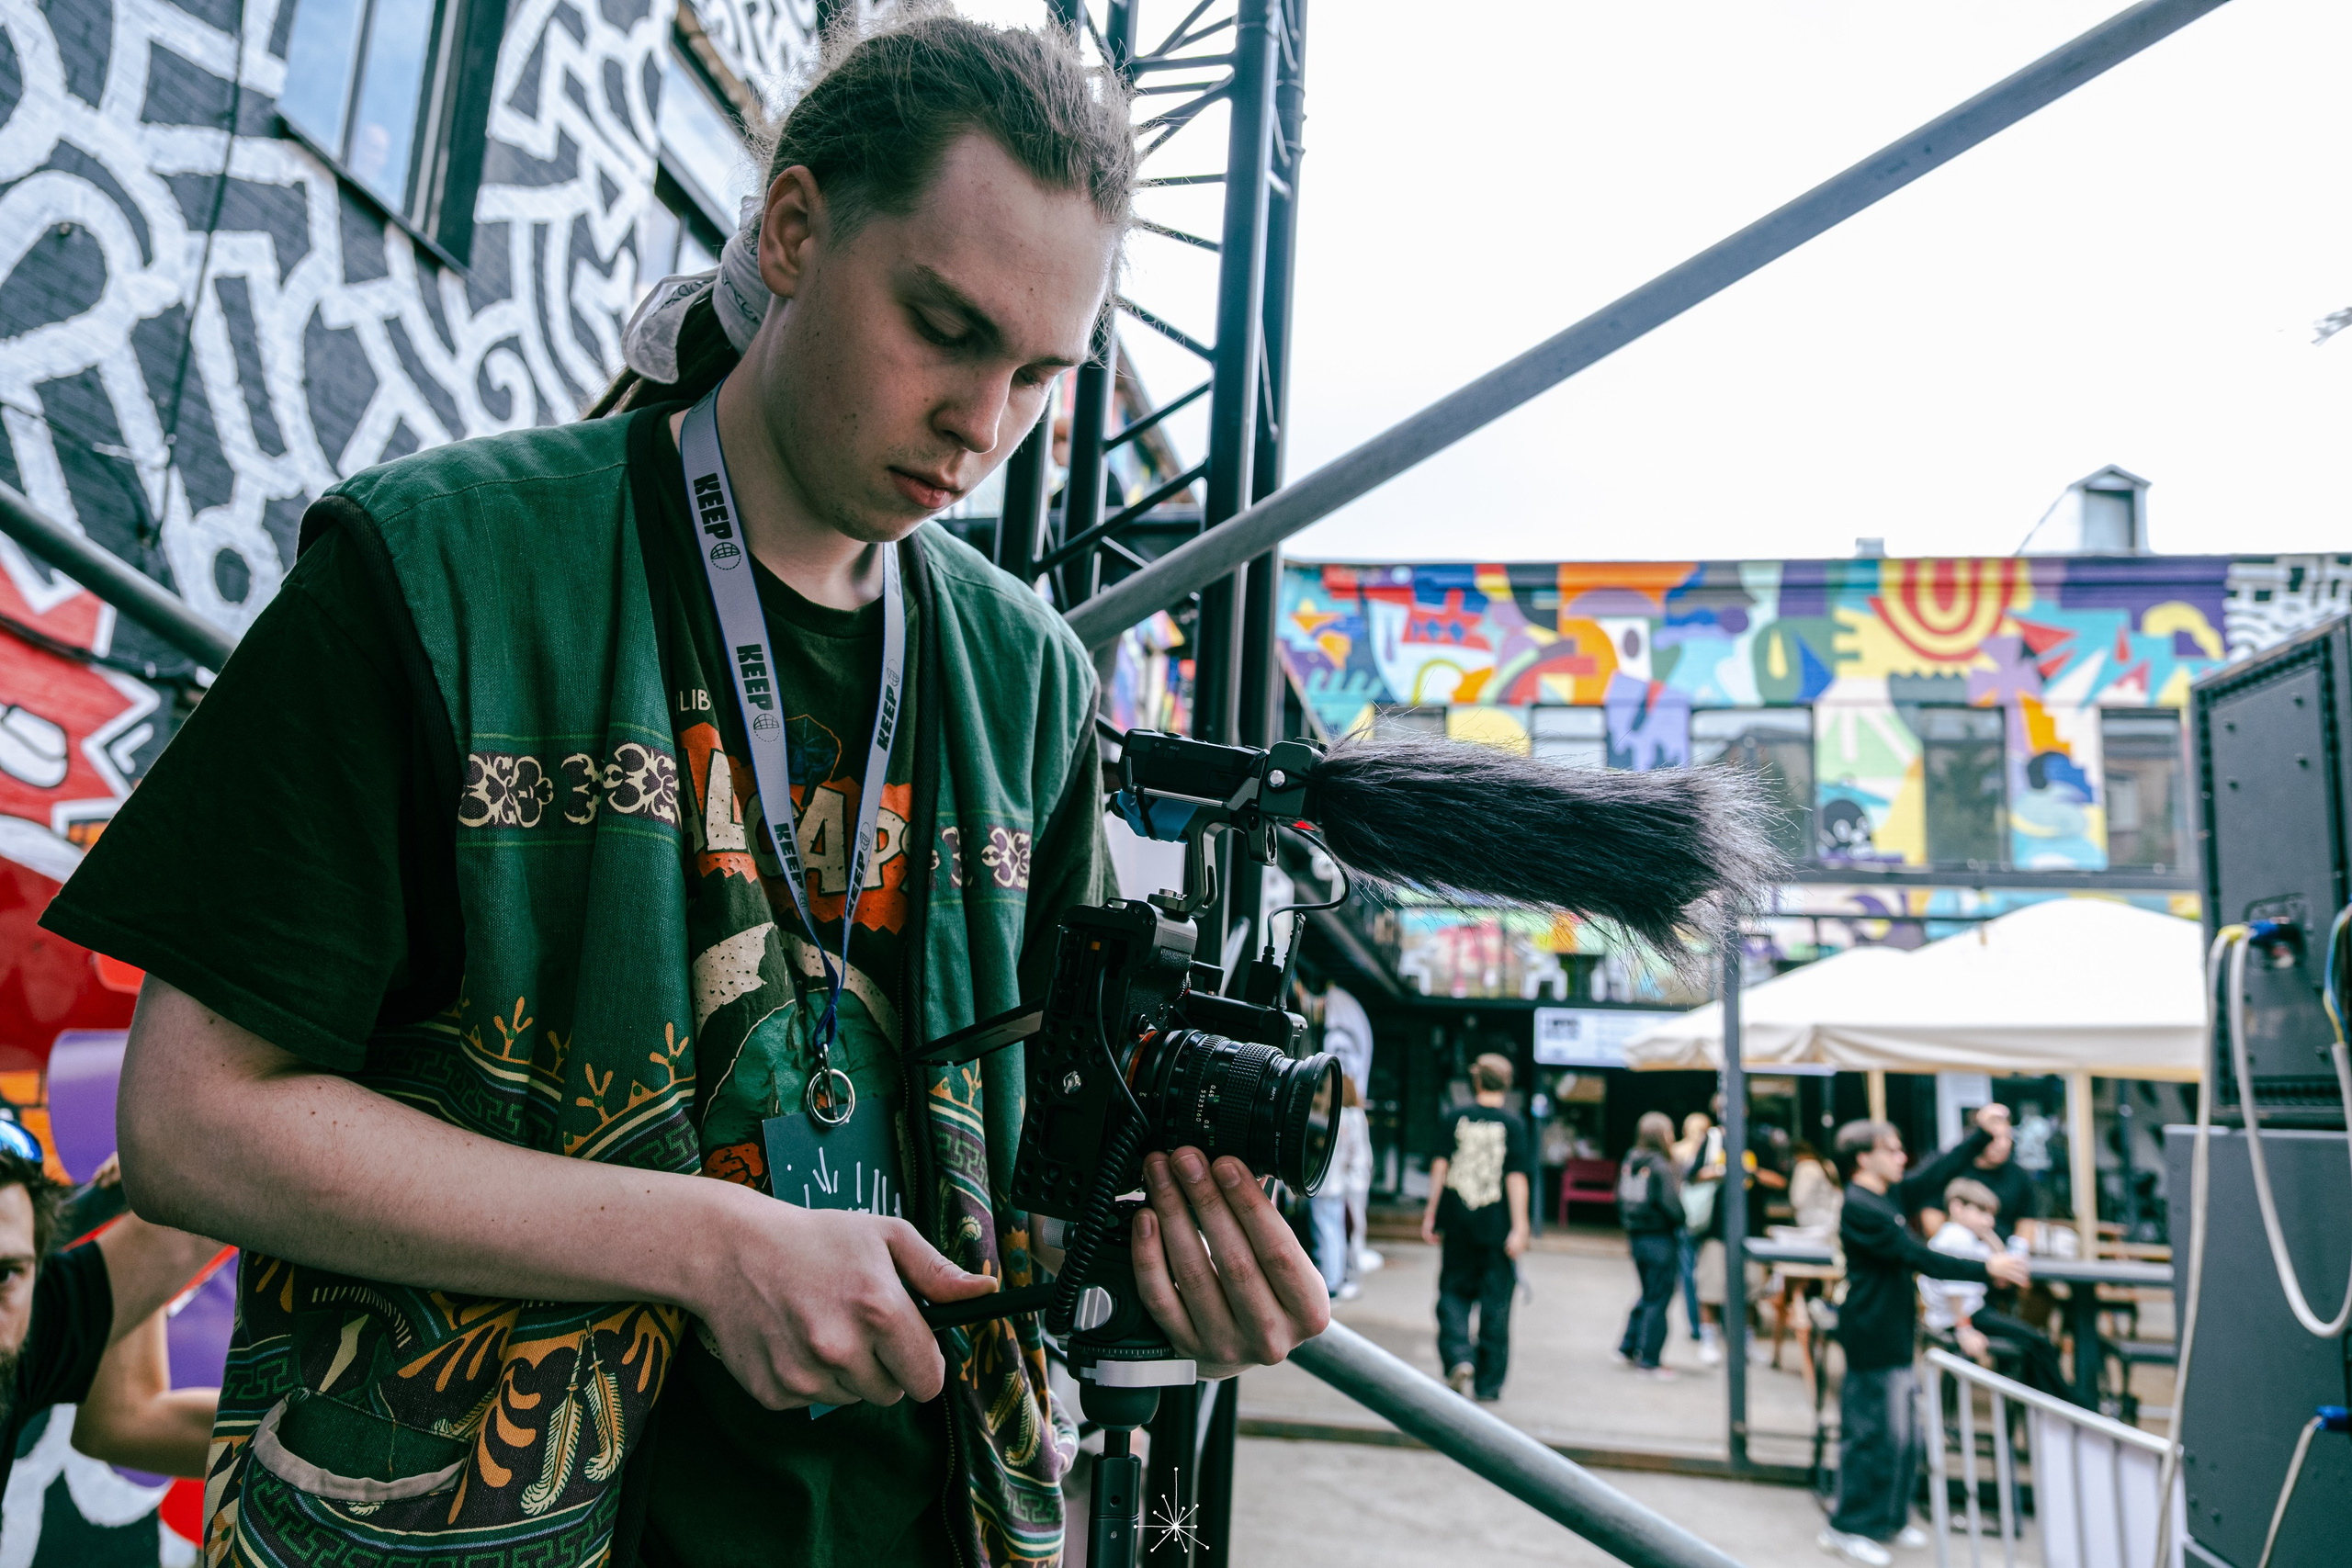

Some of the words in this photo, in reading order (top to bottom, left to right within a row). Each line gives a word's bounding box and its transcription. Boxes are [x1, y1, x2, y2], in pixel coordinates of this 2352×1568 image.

[694, 473, 733, 539] KEEP
[736, 644, 774, 711] KEEP
[876, 684, 897, 751] KEEP
[773, 822, 804, 896] KEEP
[846, 852, 867, 919] KEEP
